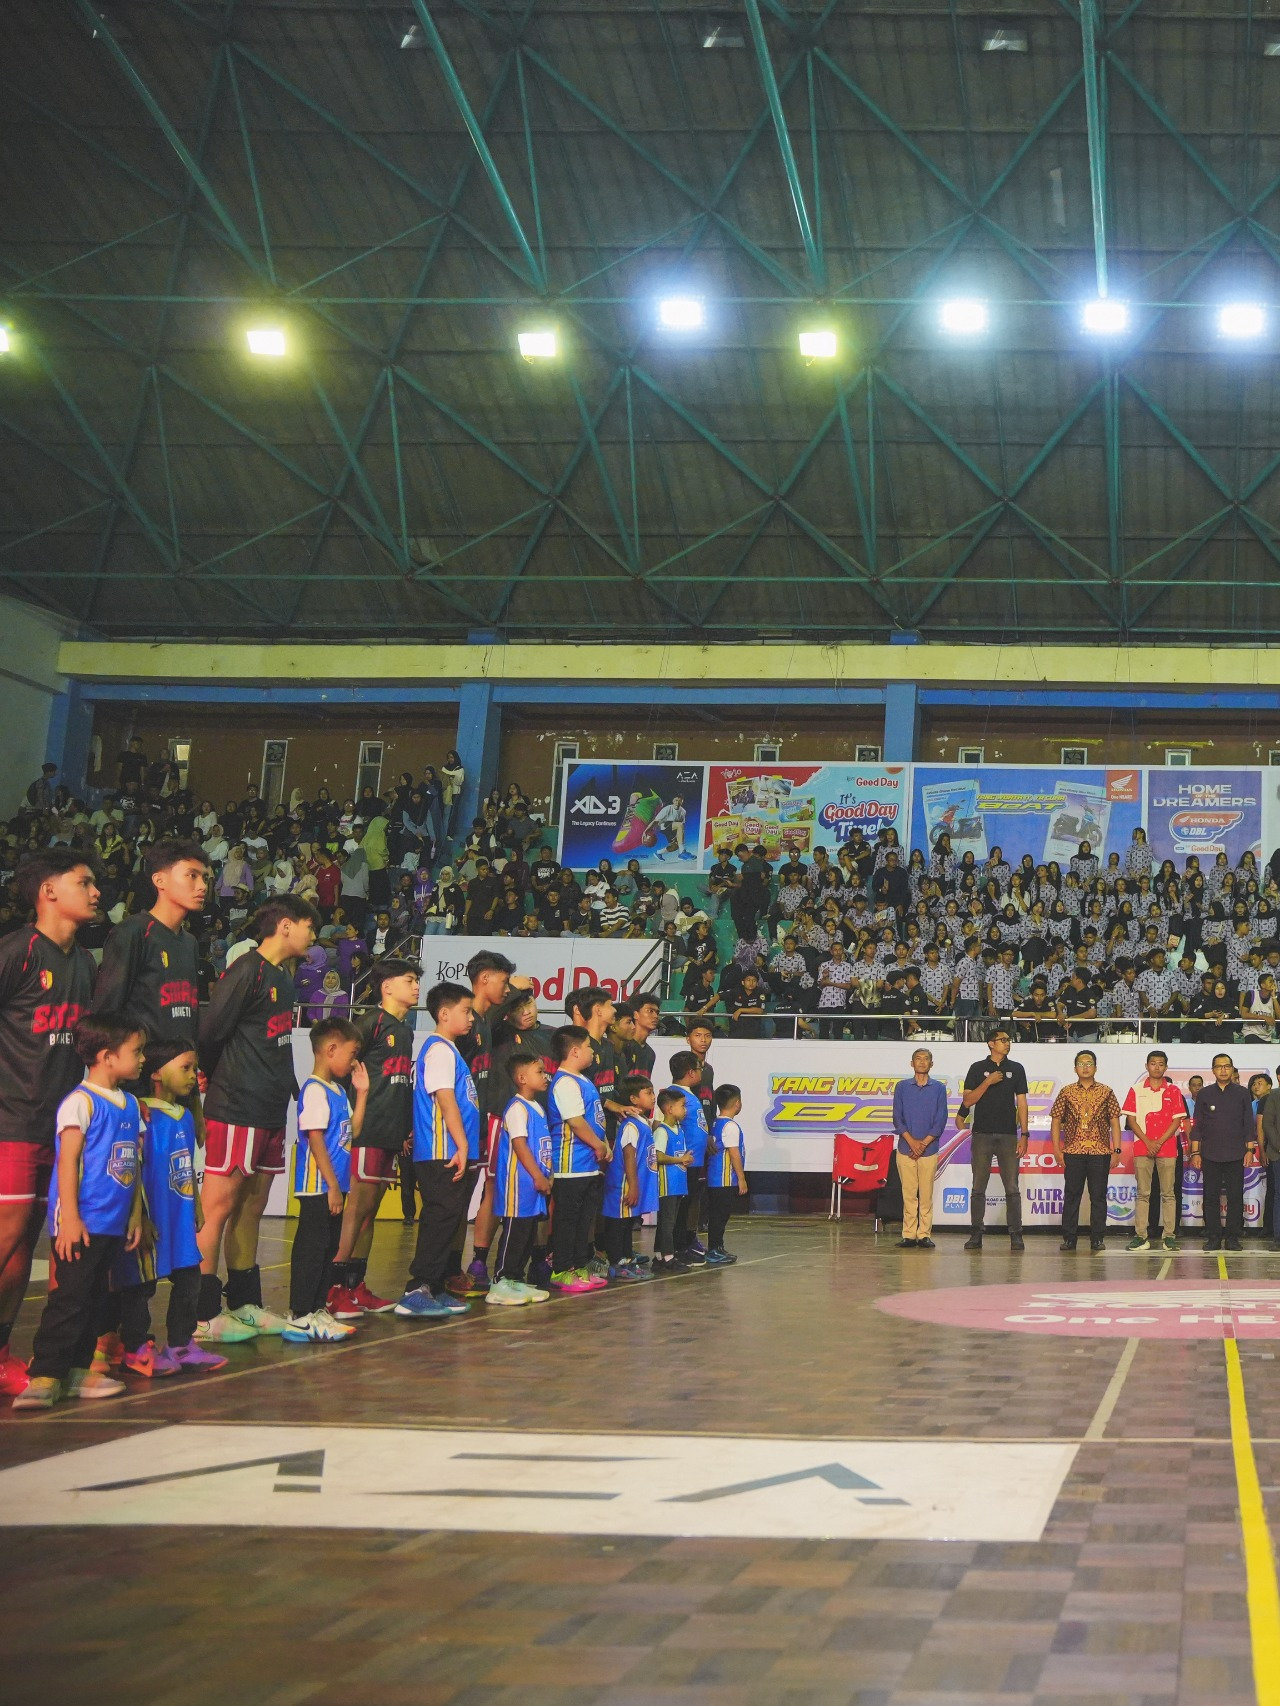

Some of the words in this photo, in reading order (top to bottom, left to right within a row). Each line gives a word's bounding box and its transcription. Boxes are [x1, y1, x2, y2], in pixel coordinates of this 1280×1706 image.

[856, 777, 879, 787] Good
[880, 777, 899, 788] Day
[1178, 784, 1232, 794] HOME
[840, 793, 856, 804] It's
[1153, 797, 1257, 807] DREAMERS
[824, 802, 866, 823] Good
[866, 801, 898, 820] Day
[1189, 828, 1207, 836] DBL
[1191, 844, 1208, 852] Good
[772, 1076, 836, 1096] YANG
[836, 1077, 898, 1096] WORT
[178, 1156, 192, 1168] DB
[946, 1194, 966, 1204] DBL
[1106, 1186, 1138, 1204] QUA
[1003, 1313, 1160, 1324] One
